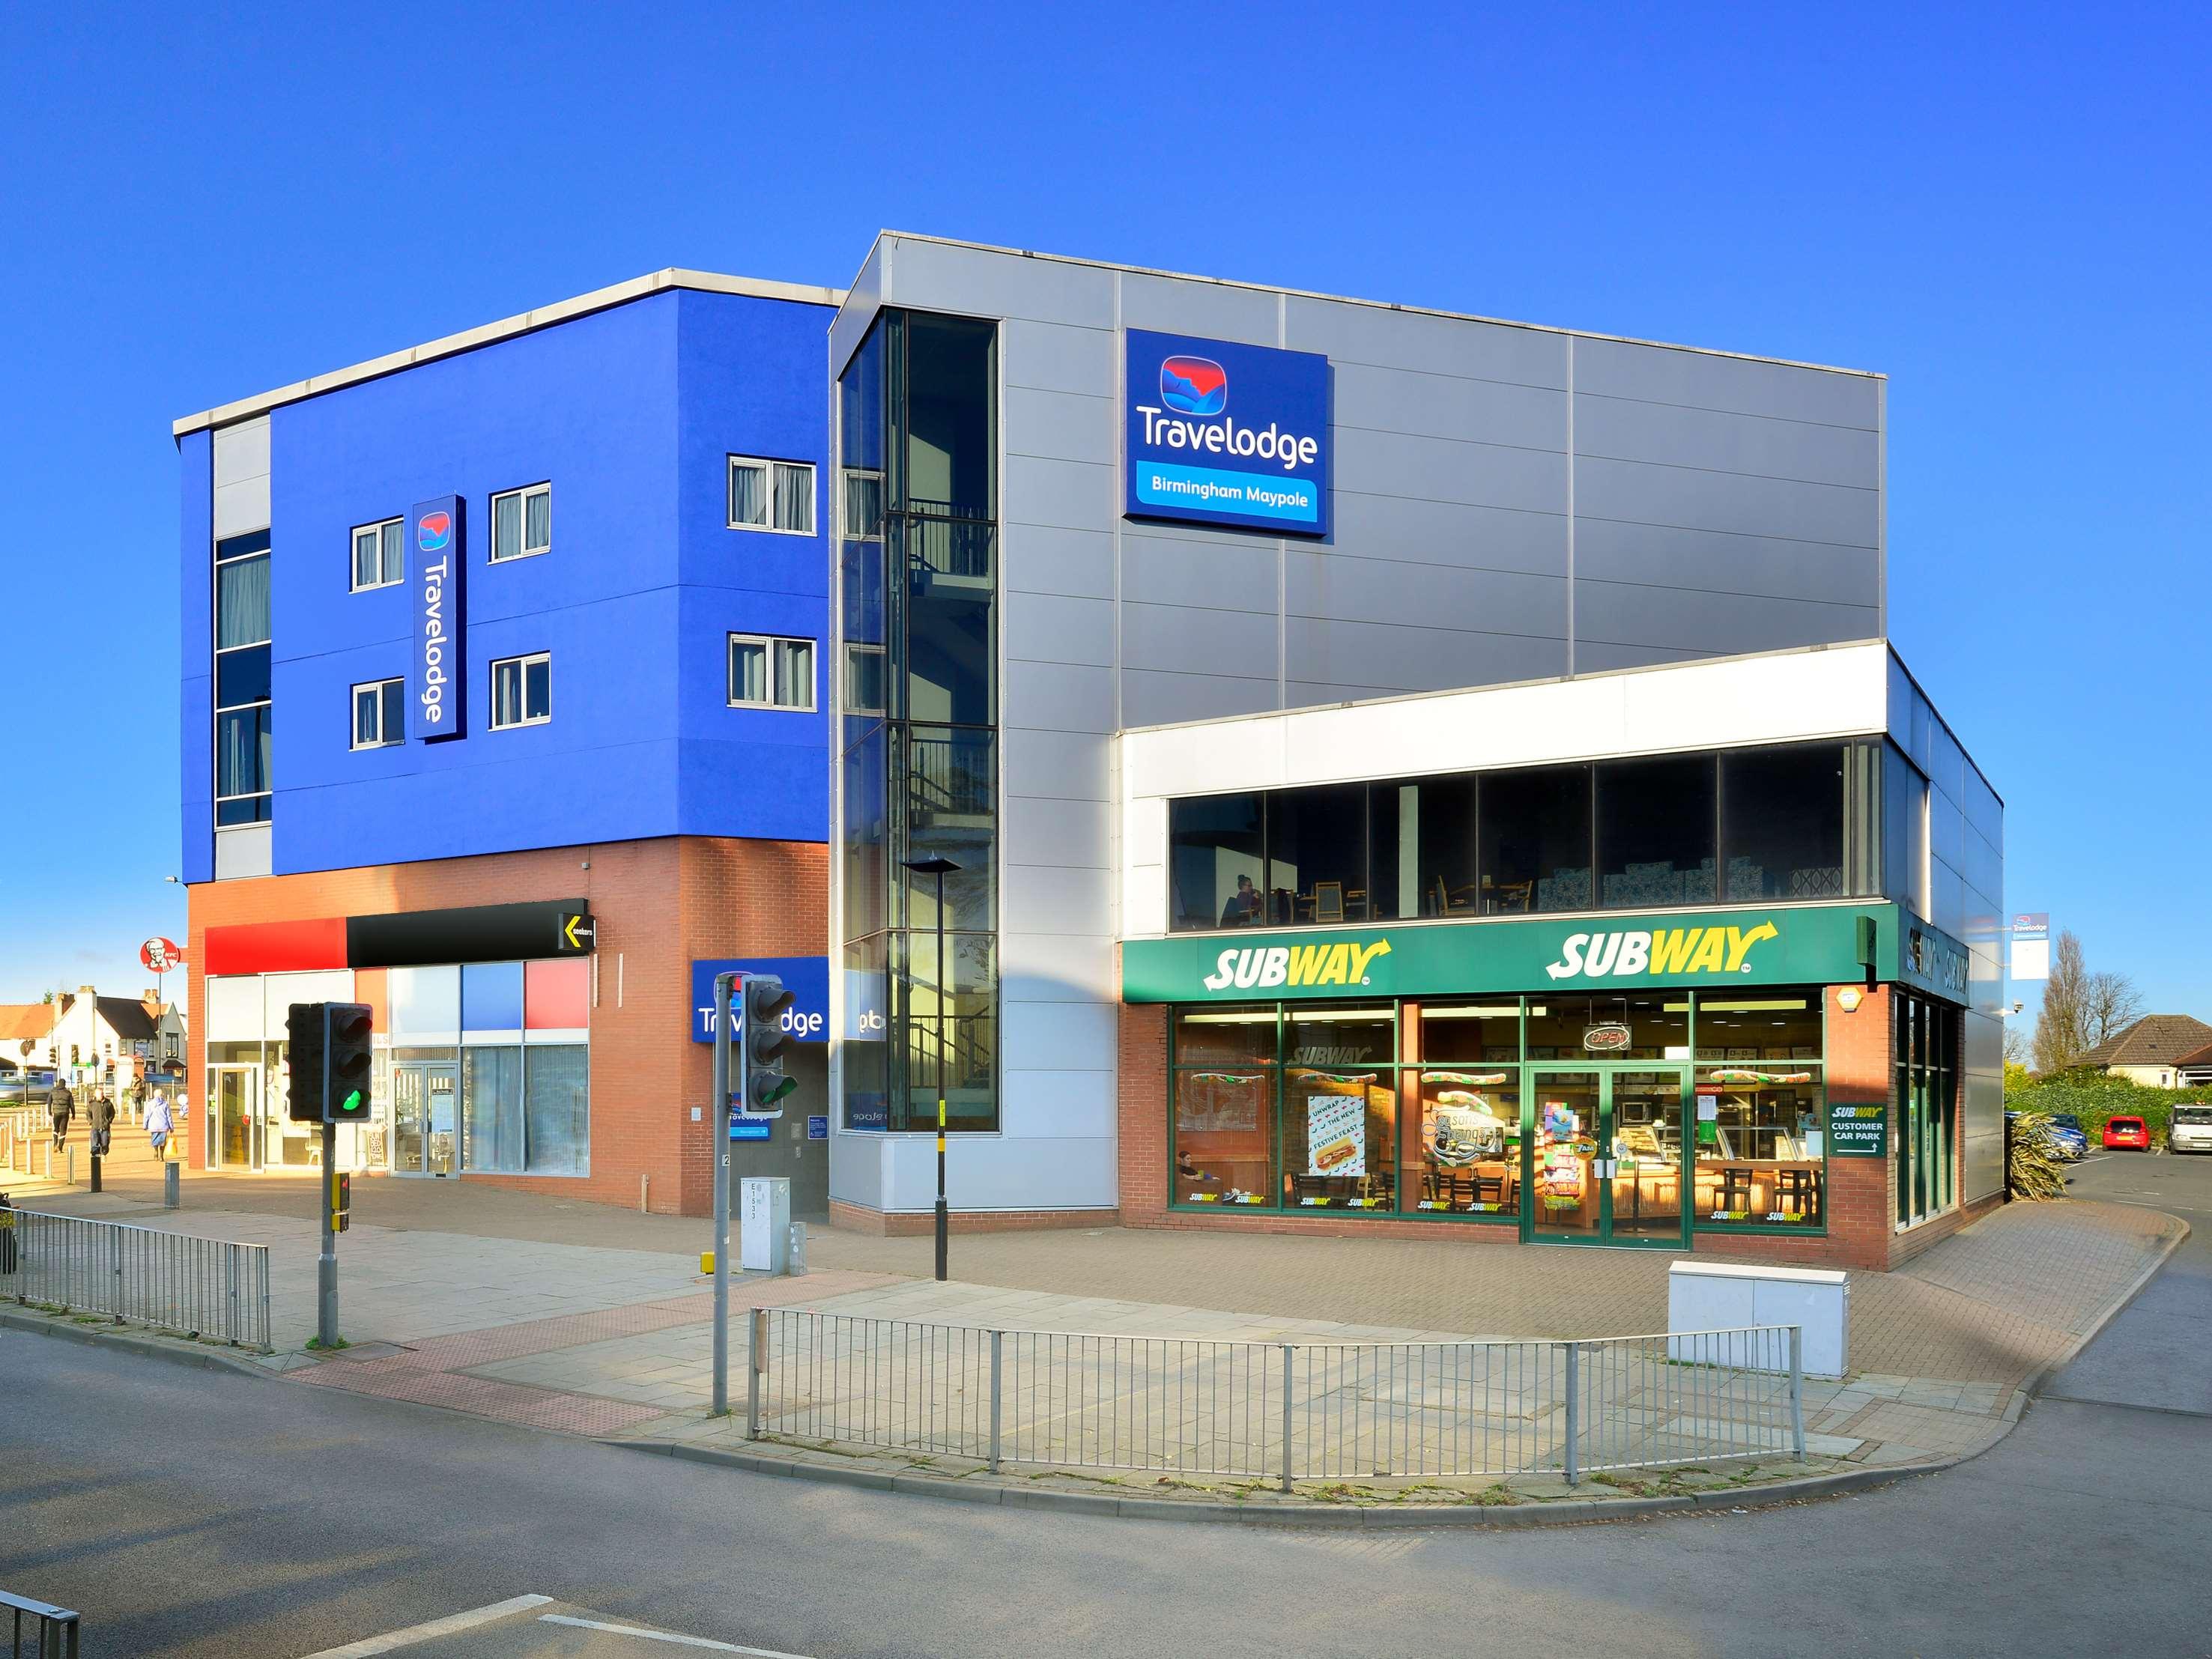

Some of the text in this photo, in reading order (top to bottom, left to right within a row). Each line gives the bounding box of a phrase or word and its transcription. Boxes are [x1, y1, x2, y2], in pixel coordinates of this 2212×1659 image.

[1136, 406, 1318, 470] Travelodge
[1152, 476, 1308, 507] Birmingham Maypole
[421, 555, 447, 724] Travelodge
[1545, 921, 1778, 981] SUBWAY
[1203, 938, 1392, 992] SUBWAY
[698, 1007, 823, 1037] Trvdge
[1592, 1032, 1627, 1043] OPEN
[1288, 1046, 1372, 1064] SUBWAY
[1312, 1100, 1339, 1117] UNWRAP
[1831, 1107, 1883, 1117] SUBWAY
[1328, 1108, 1355, 1126] THE NEW
[1313, 1123, 1358, 1150] FESTIVE FEAST
[724, 1156, 730, 1165] 2
[1190, 1193, 1217, 1201] SUBWAY
[1235, 1195, 1265, 1204] SUBWAY
[1300, 1197, 1330, 1205] SUBWAY
[1348, 1198, 1378, 1207] SUBWAY
[1417, 1201, 1450, 1210] SUBWAY
[1467, 1202, 1502, 1211] SUBWAY
[1710, 1210, 1749, 1219] SUBWAY
[1766, 1212, 1805, 1221] SUBWAY
